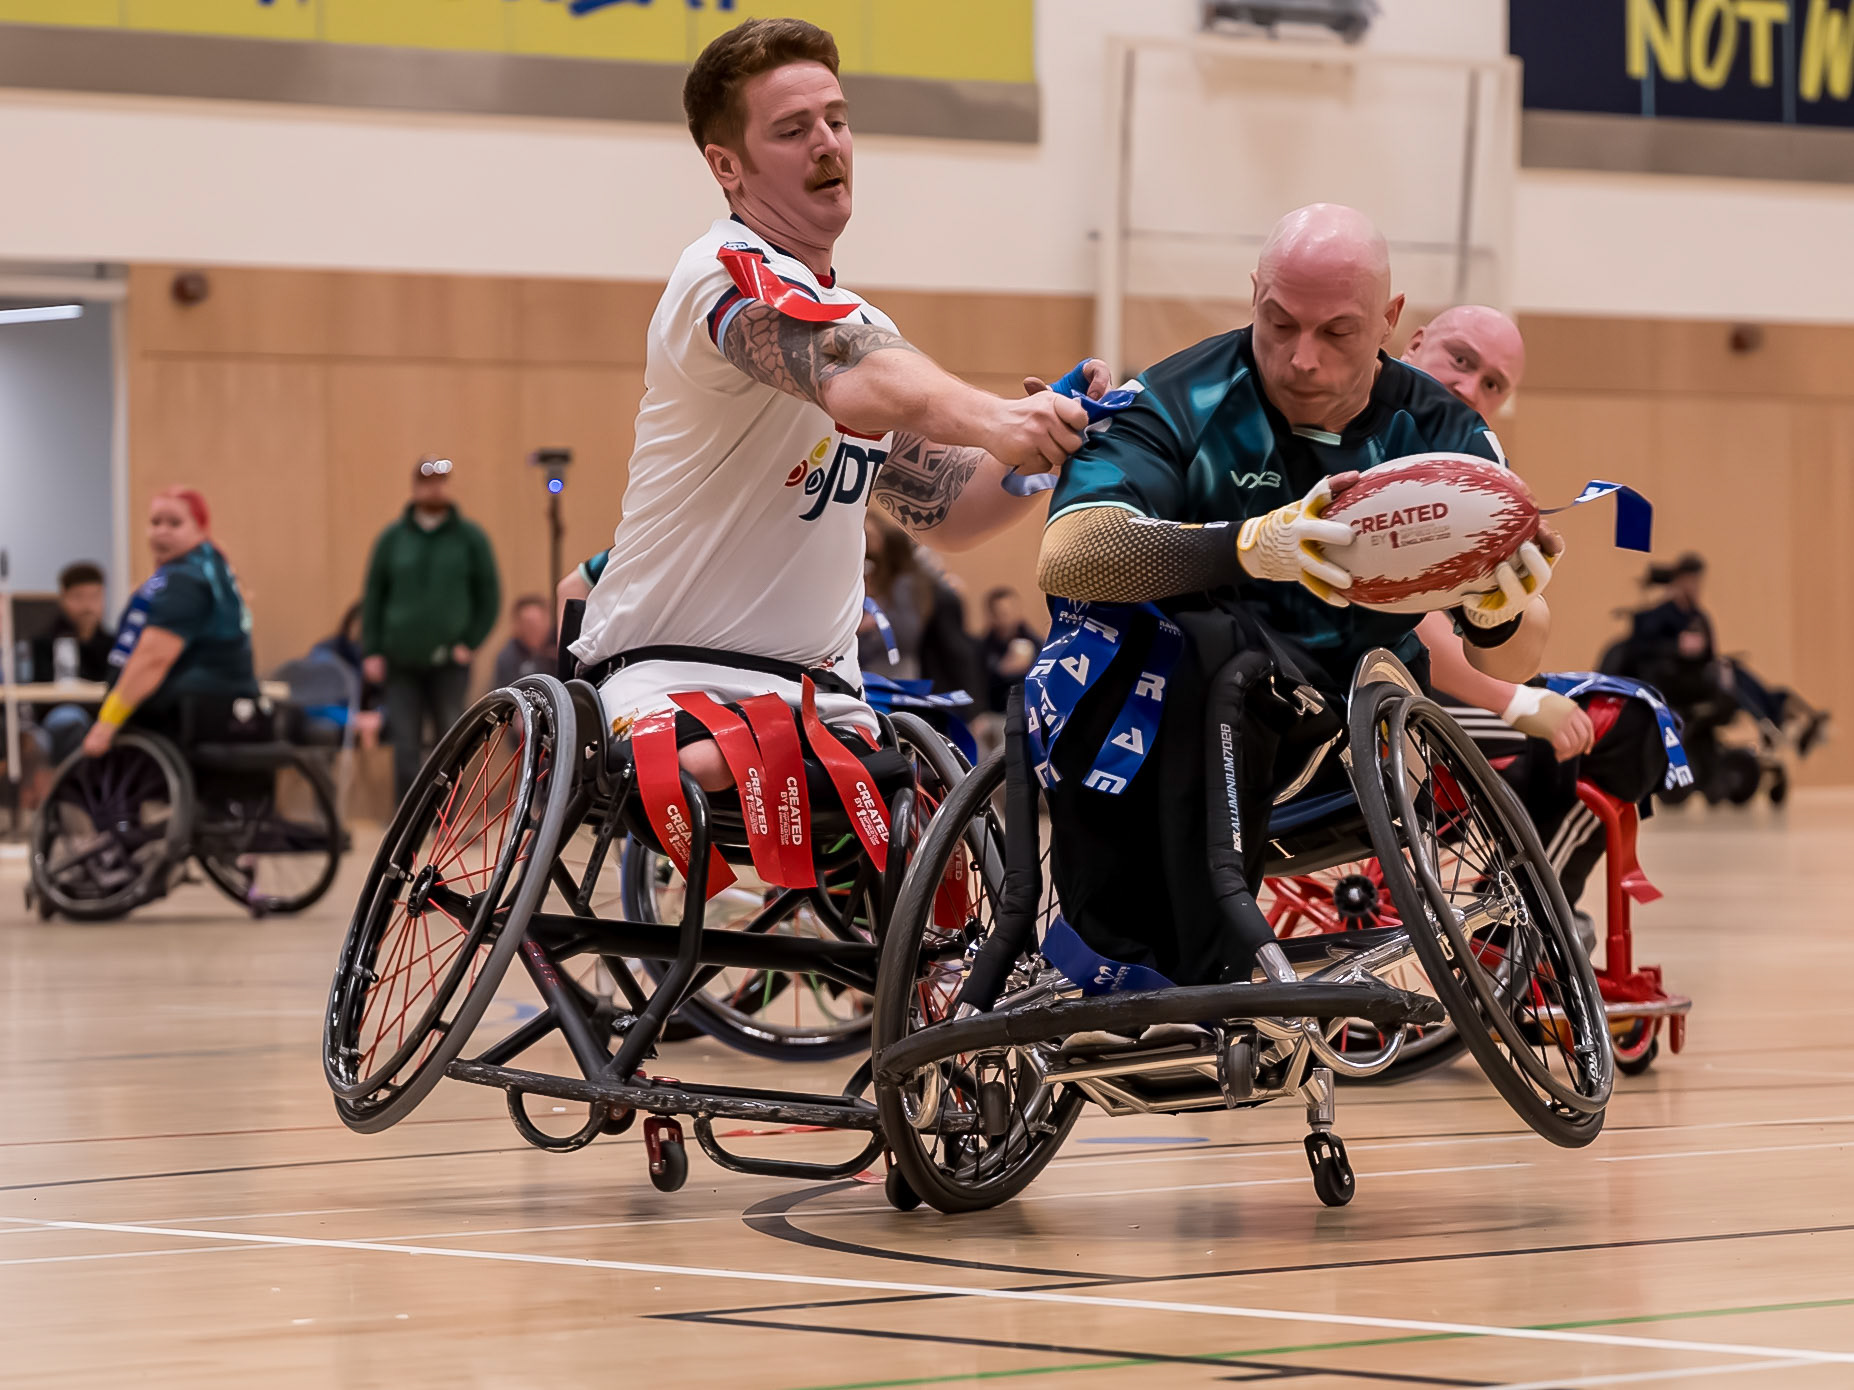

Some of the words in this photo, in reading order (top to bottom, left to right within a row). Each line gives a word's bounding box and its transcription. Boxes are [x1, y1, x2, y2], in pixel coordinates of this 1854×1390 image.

[1626, 0, 1789, 90] NOT
[1230, 470, 1282, 489] VX3
[667, 804, 692, 846] CREA
[748, 767, 768, 835] CREATED
[786, 776, 803, 846] CREATED
[855, 781, 890, 843] CREATED
